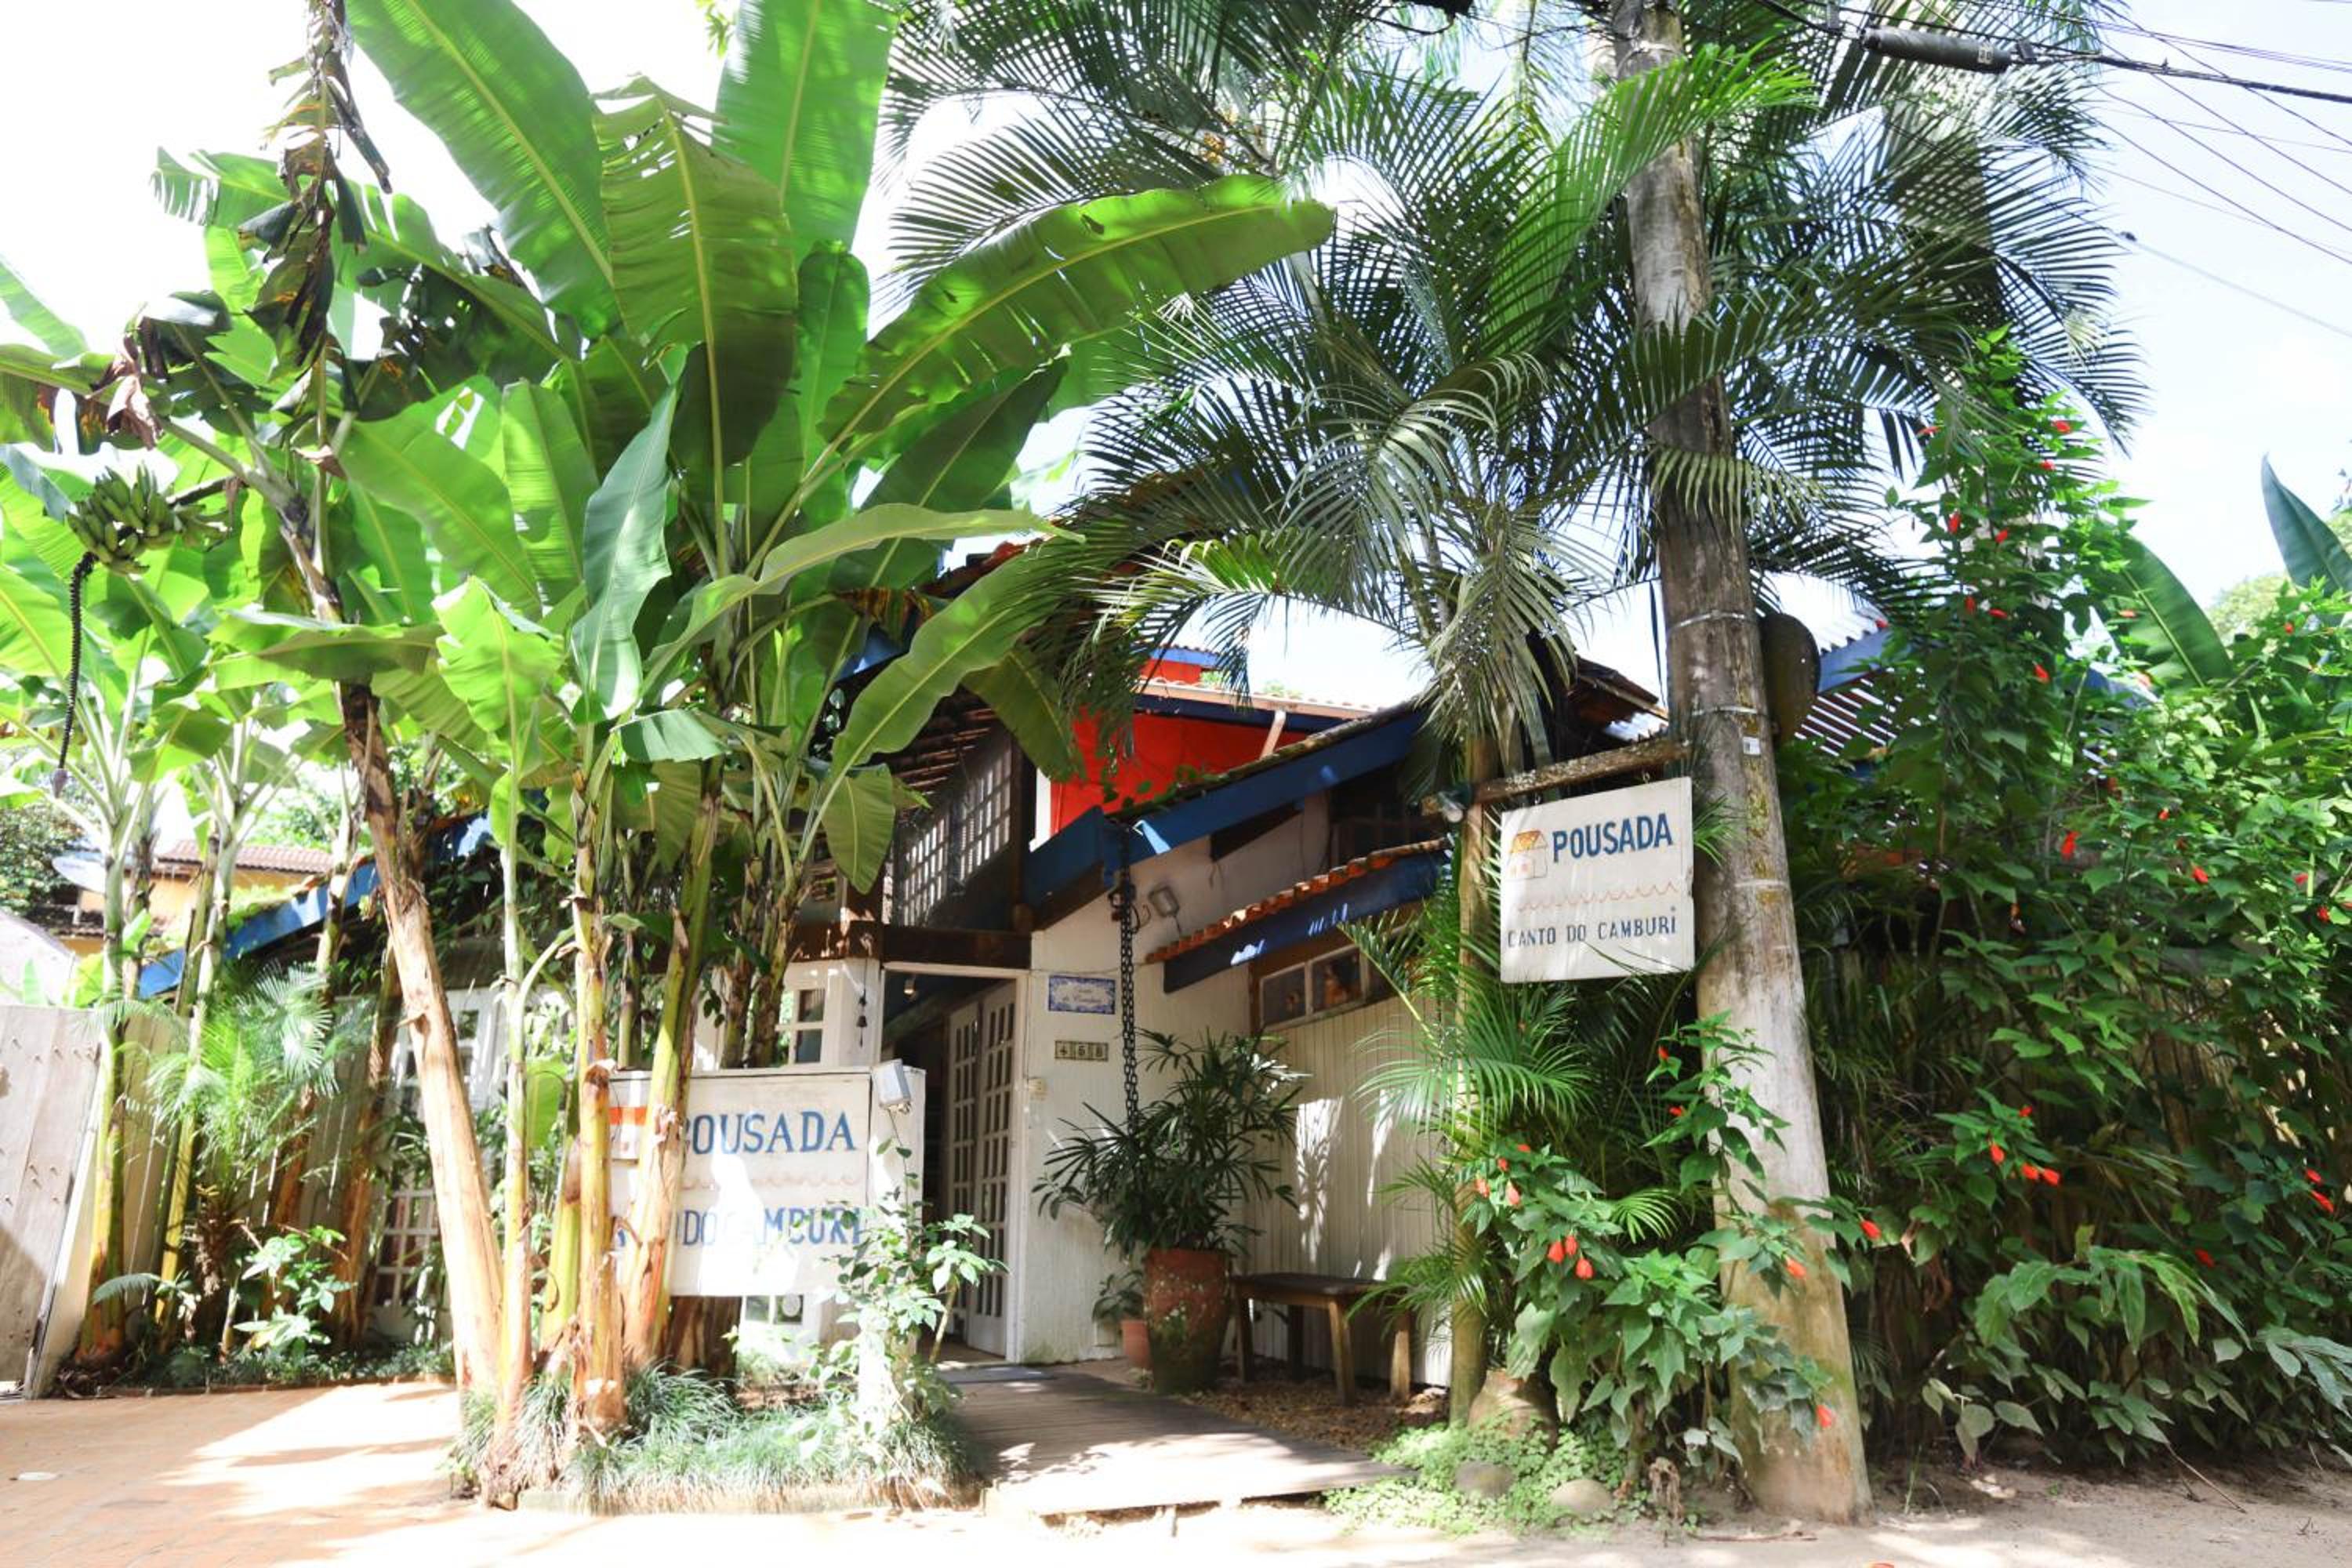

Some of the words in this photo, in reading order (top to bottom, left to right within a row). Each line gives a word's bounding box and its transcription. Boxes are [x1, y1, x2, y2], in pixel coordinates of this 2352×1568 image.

[1552, 812, 1673, 862] POUSADA
[1508, 927, 1556, 947] CANTO
[1566, 924, 1587, 942] DO
[684, 1111, 857, 1155] OUSADA
